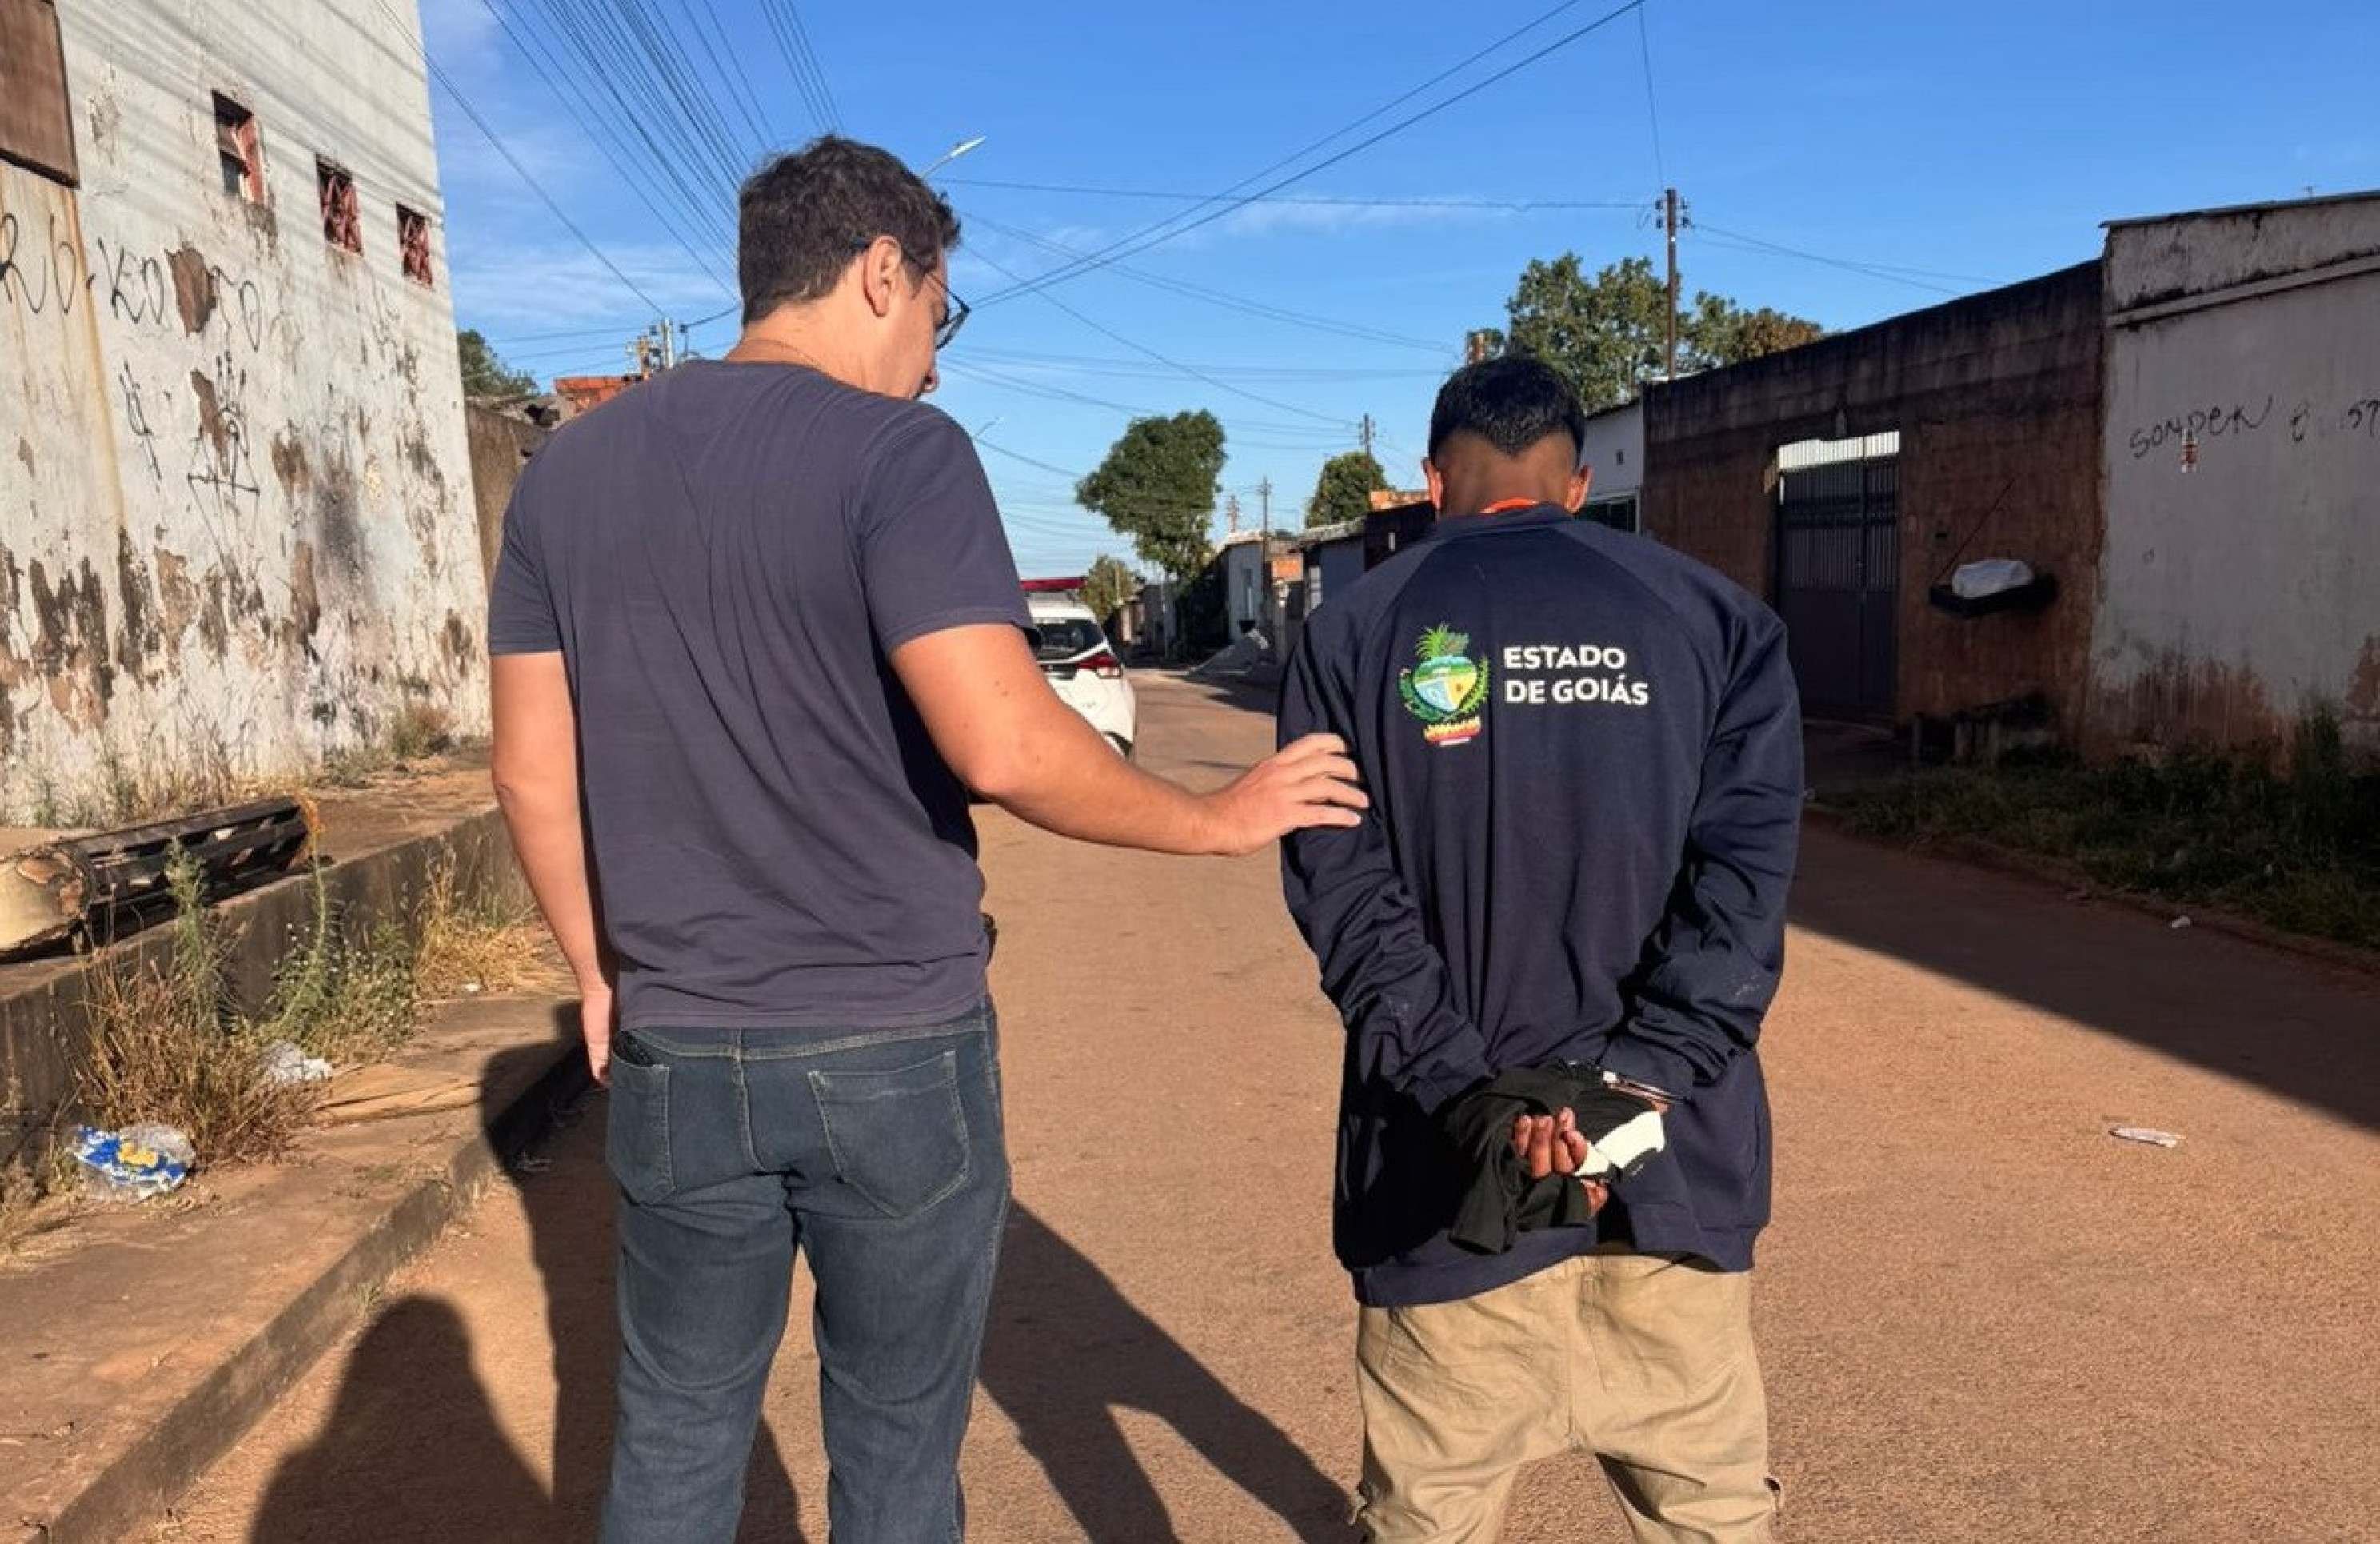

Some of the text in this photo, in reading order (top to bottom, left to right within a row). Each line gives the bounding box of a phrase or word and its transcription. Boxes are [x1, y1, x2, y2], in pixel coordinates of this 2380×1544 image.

[1503, 645, 1627, 670] ESTADO
[1504, 673, 1649, 706] DE GOIÁS
